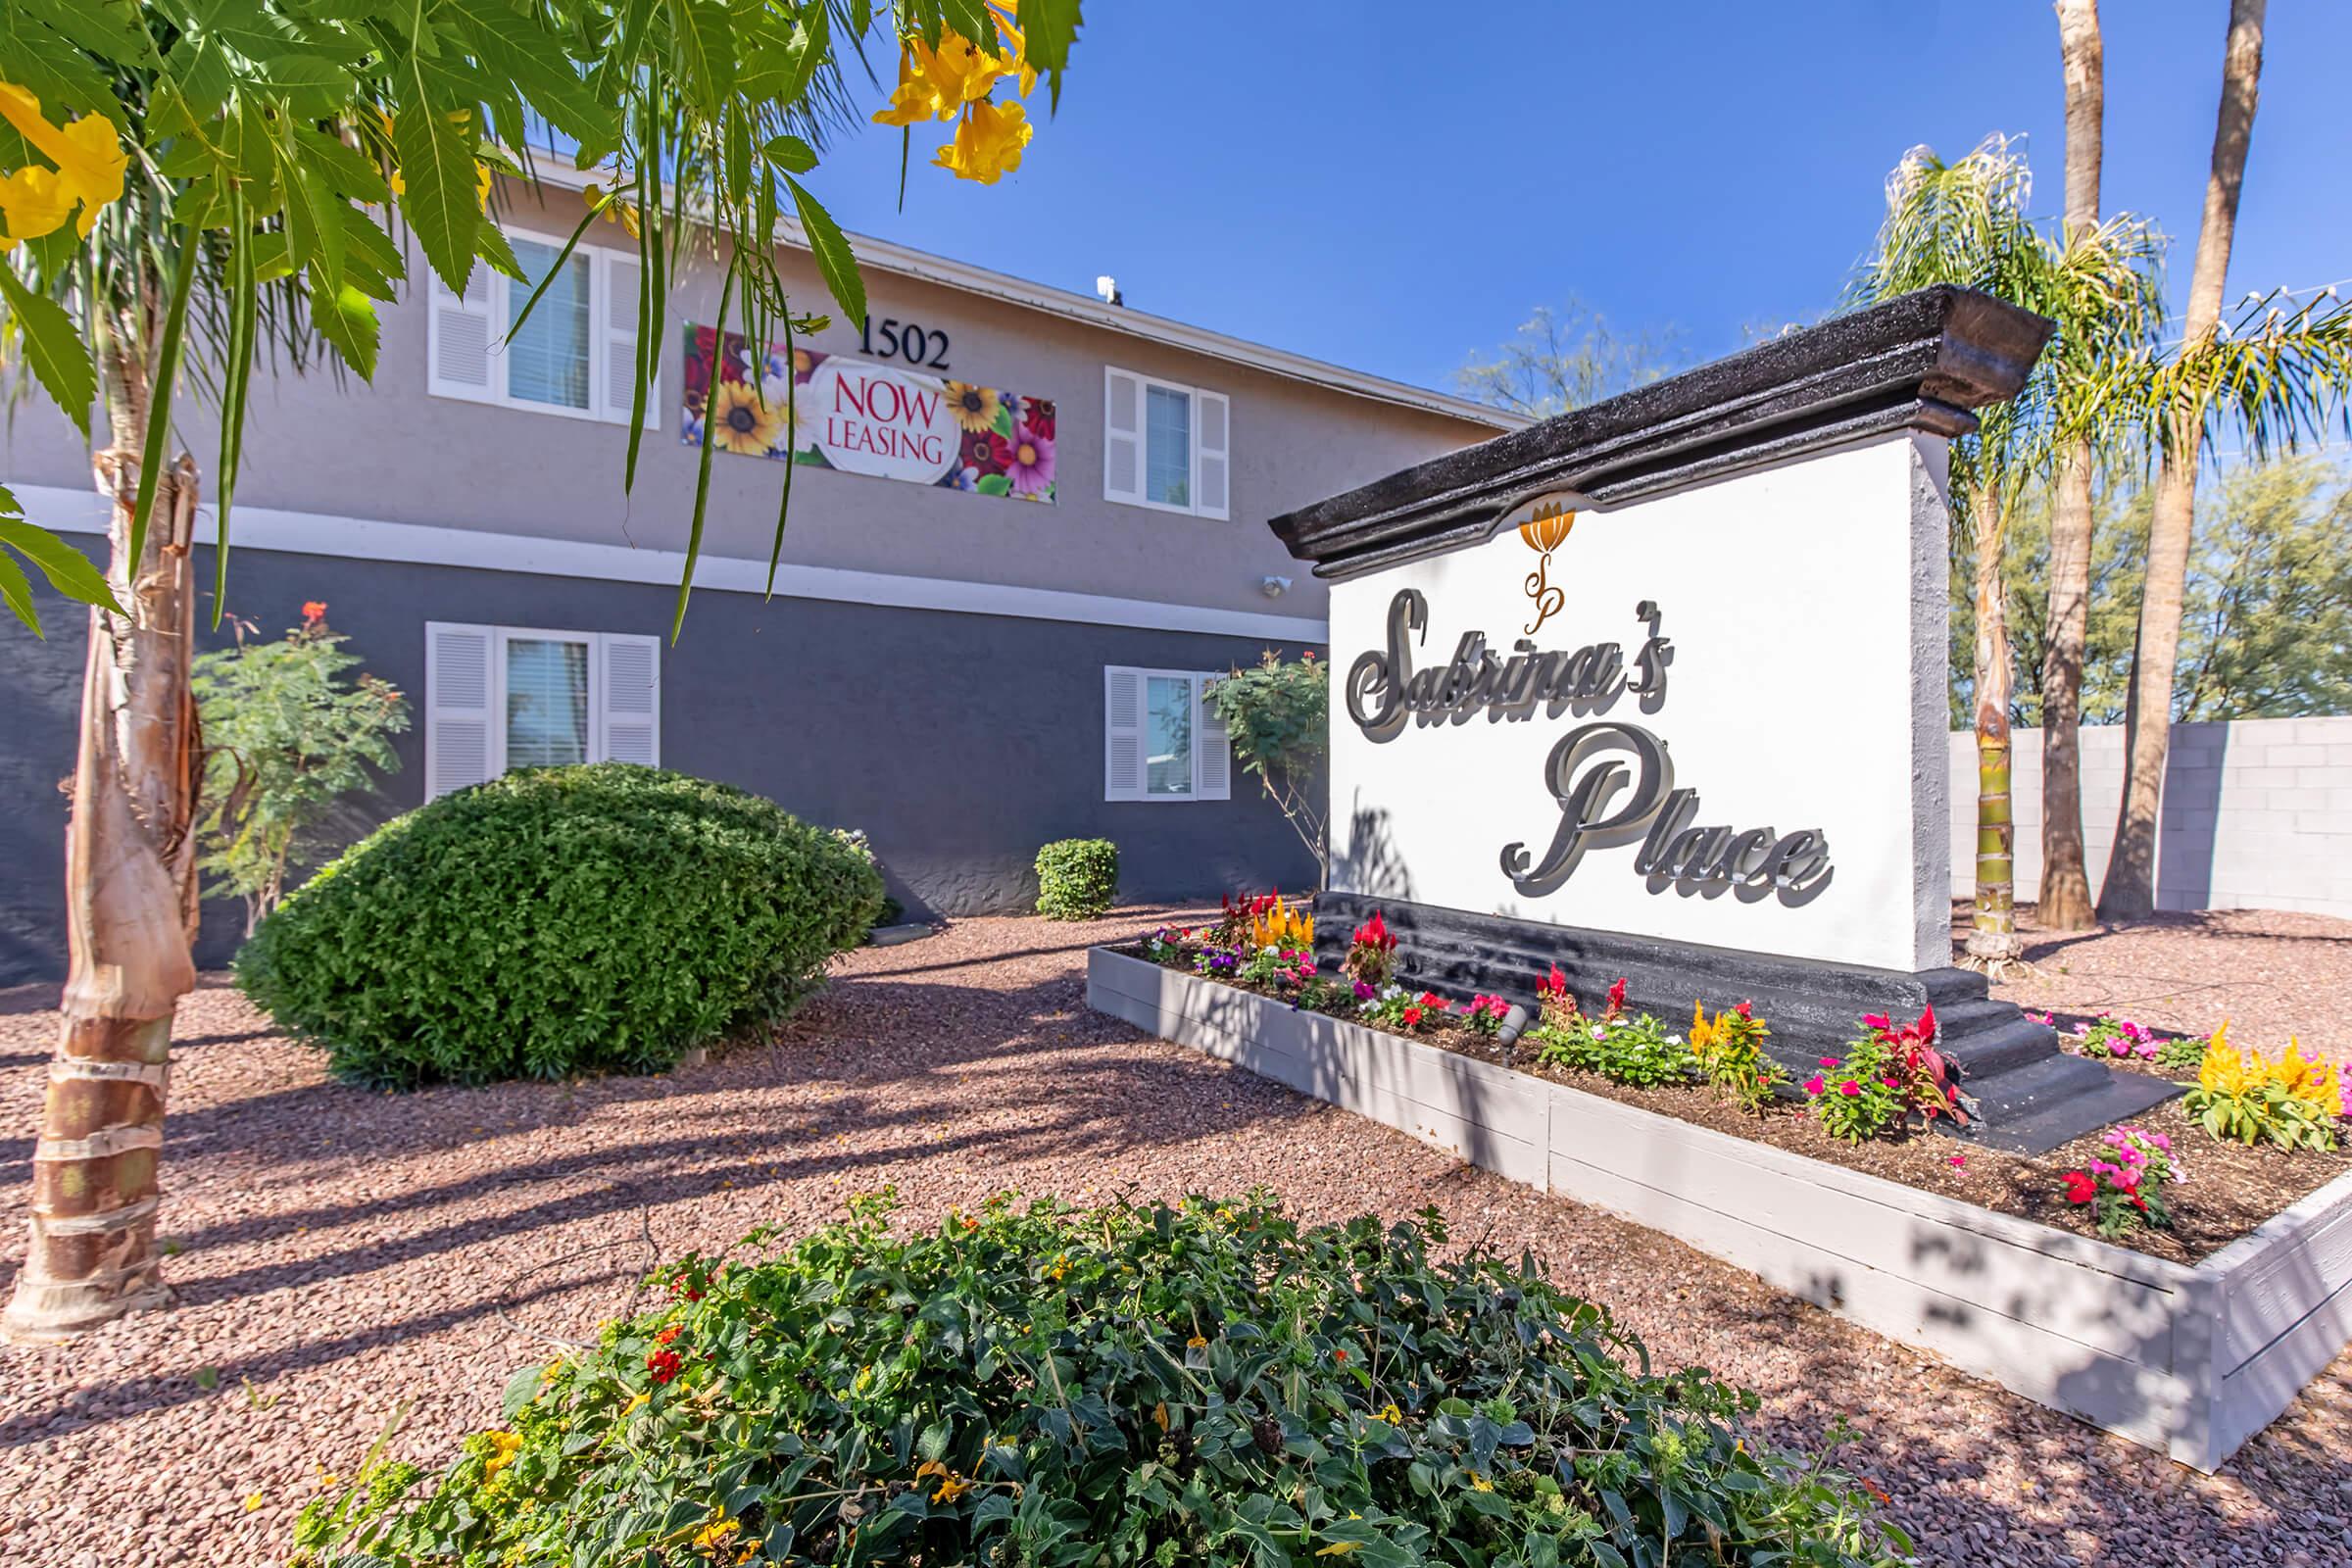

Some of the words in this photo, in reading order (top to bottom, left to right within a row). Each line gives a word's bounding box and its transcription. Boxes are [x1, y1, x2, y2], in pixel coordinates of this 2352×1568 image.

[858, 314, 950, 369] 1502
[833, 371, 940, 429] NOW
[827, 417, 942, 465] LEASING
[1346, 588, 1675, 732] Sabrina's
[1499, 721, 1834, 899] Place
